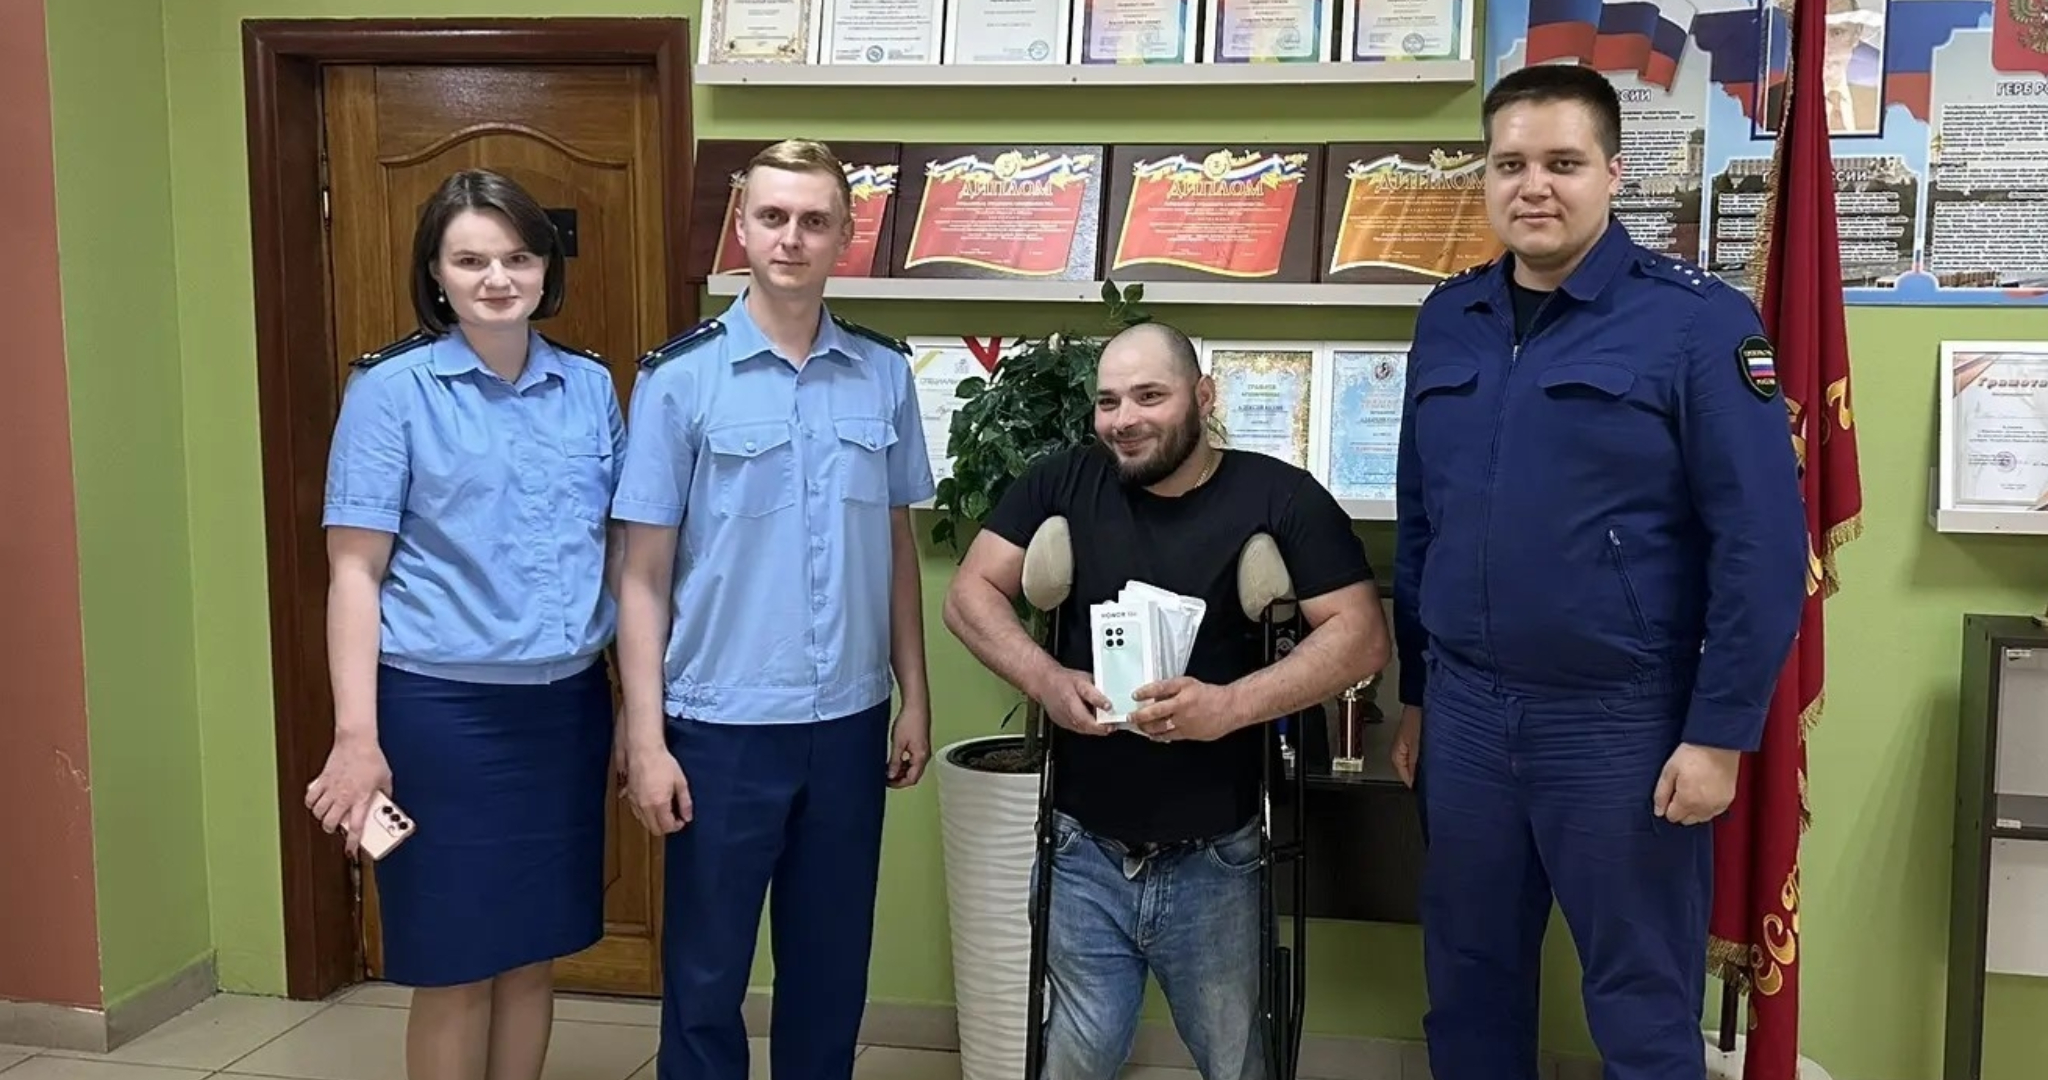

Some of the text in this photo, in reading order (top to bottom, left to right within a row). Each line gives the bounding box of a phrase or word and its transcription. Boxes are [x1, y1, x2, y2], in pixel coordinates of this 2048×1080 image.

[1997, 82, 2032, 95] ГЕРБ
[1617, 89, 1651, 102] СИИ
[1832, 170, 1868, 182] СИИ
[958, 179, 1053, 199] ДИПЛОМ
[1167, 179, 1264, 199] ДИПЛОМ
[1978, 377, 2048, 389] Грамота
[1101, 611, 1126, 619] HONOR
